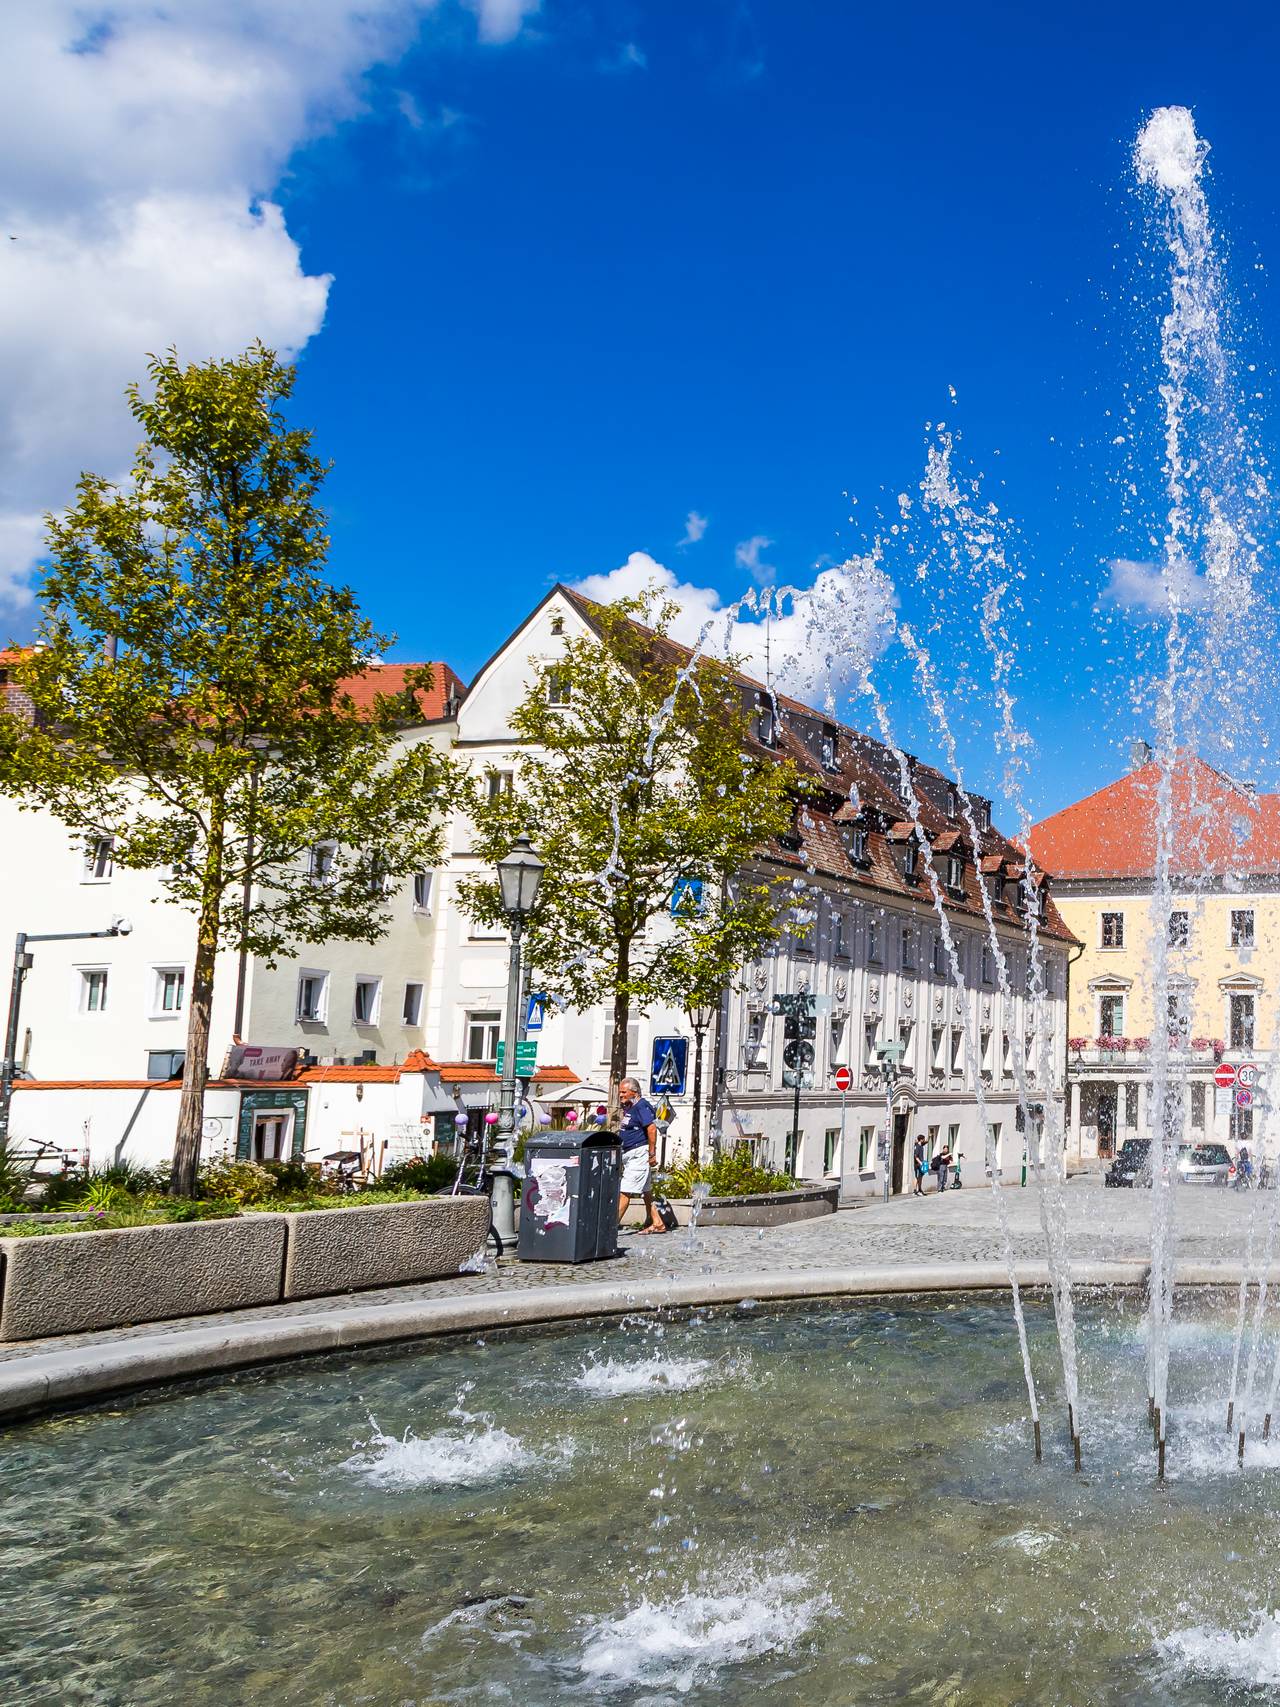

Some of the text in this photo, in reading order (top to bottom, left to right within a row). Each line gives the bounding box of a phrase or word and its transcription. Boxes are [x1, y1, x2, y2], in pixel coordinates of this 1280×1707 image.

[250, 1055, 281, 1066] TAKE AWAY
[1241, 1070, 1255, 1082] 30
